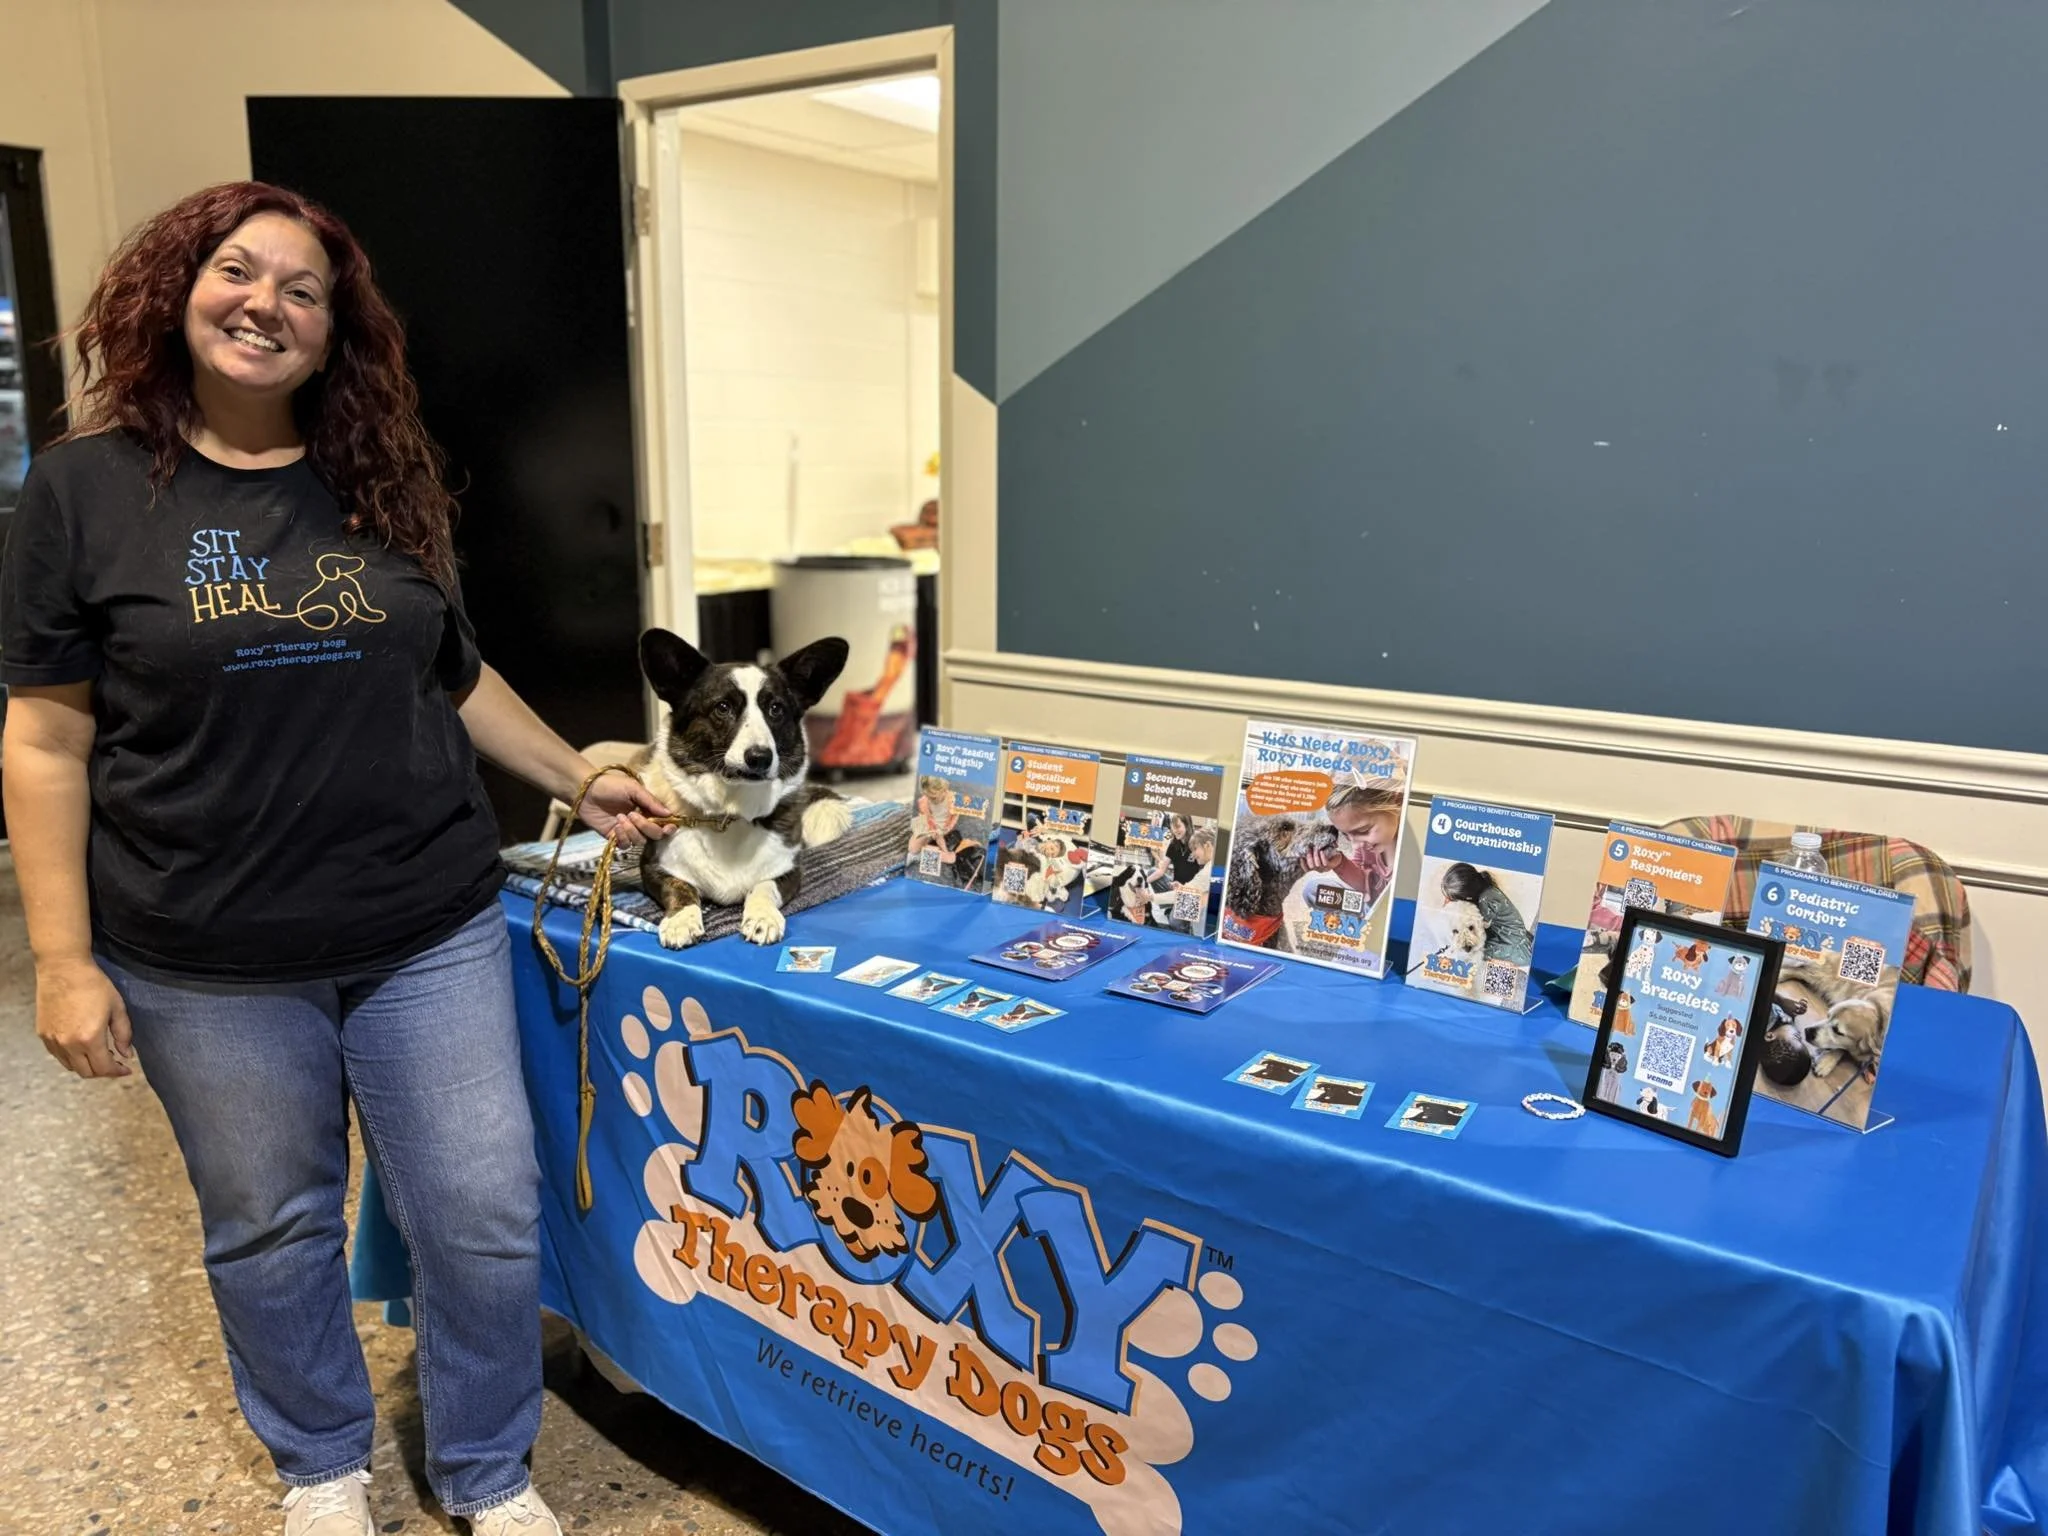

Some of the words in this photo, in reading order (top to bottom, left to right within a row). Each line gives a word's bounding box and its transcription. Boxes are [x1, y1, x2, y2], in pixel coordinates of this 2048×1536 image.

[190, 530, 240, 557] SIT
[185, 555, 269, 585] STAY
[188, 583, 281, 623] HEAL
[273, 640, 319, 654] Therapy
[322, 638, 347, 649] Dogs
[222, 650, 361, 673] www.roxytherapydogs.org
[925, 744, 931, 754] 1
[1262, 731, 1297, 749] Kids
[1301, 736, 1342, 754] Need
[934, 764, 968, 777] Program
[935, 754, 950, 762] Our
[951, 756, 984, 770] flagship
[1014, 760, 1022, 770] 2
[1027, 760, 1064, 772] Student
[1257, 748, 1297, 767] Roxy
[1301, 753, 1353, 772] Needs
[1357, 760, 1396, 779] You!
[1026, 770, 1077, 785] Specialized
[1131, 772, 1140, 783] 3
[1146, 772, 1196, 788] Secondary
[1025, 780, 1060, 793] Support
[1144, 783, 1174, 796] School
[1175, 788, 1208, 800] Stress
[1143, 794, 1174, 808] Relief
[1446, 802, 1478, 813] PROGRAMS
[1486, 807, 1510, 817] BENEFIT
[1510, 810, 1541, 822] CHILDREN
[1438, 818, 1446, 830] 4
[1454, 818, 1522, 839] Courthouse
[1453, 831, 1542, 857] Companionship
[1626, 826, 1657, 840] PROGRAMS
[1658, 833, 1666, 841] TO
[1666, 834, 1690, 846] BENEFIT
[1691, 839, 1722, 853] CHILDREN
[1614, 844, 1624, 857] 5
[1630, 860, 1703, 886] Responders
[1318, 888, 1335, 896] SCAN
[1780, 868, 1819, 884] PROGRAMS
[1820, 877, 1828, 886] TO
[1829, 878, 1860, 892] BENEFIT
[1860, 884, 1899, 900] CHILDREN
[1318, 894, 1334, 905] ME!
[1766, 887, 1778, 902] 6
[1789, 888, 1860, 917] Pediatric
[1786, 904, 1847, 930] Comfort
[1661, 966, 1702, 990] Roxy
[1640, 980, 1720, 1016] Bracelets
[1657, 1004, 1694, 1020] Suggested
[1668, 1017, 1699, 1031] Donation
[1646, 1074, 1673, 1088] venmo
[684, 1030, 1201, 1415] ROXY
[670, 1203, 938, 1395] Therapy
[945, 1342, 1129, 1486] Dogs
[757, 1336, 794, 1378] We
[801, 1376, 903, 1441] retrieve
[910, 1422, 1017, 1502] hearts!
